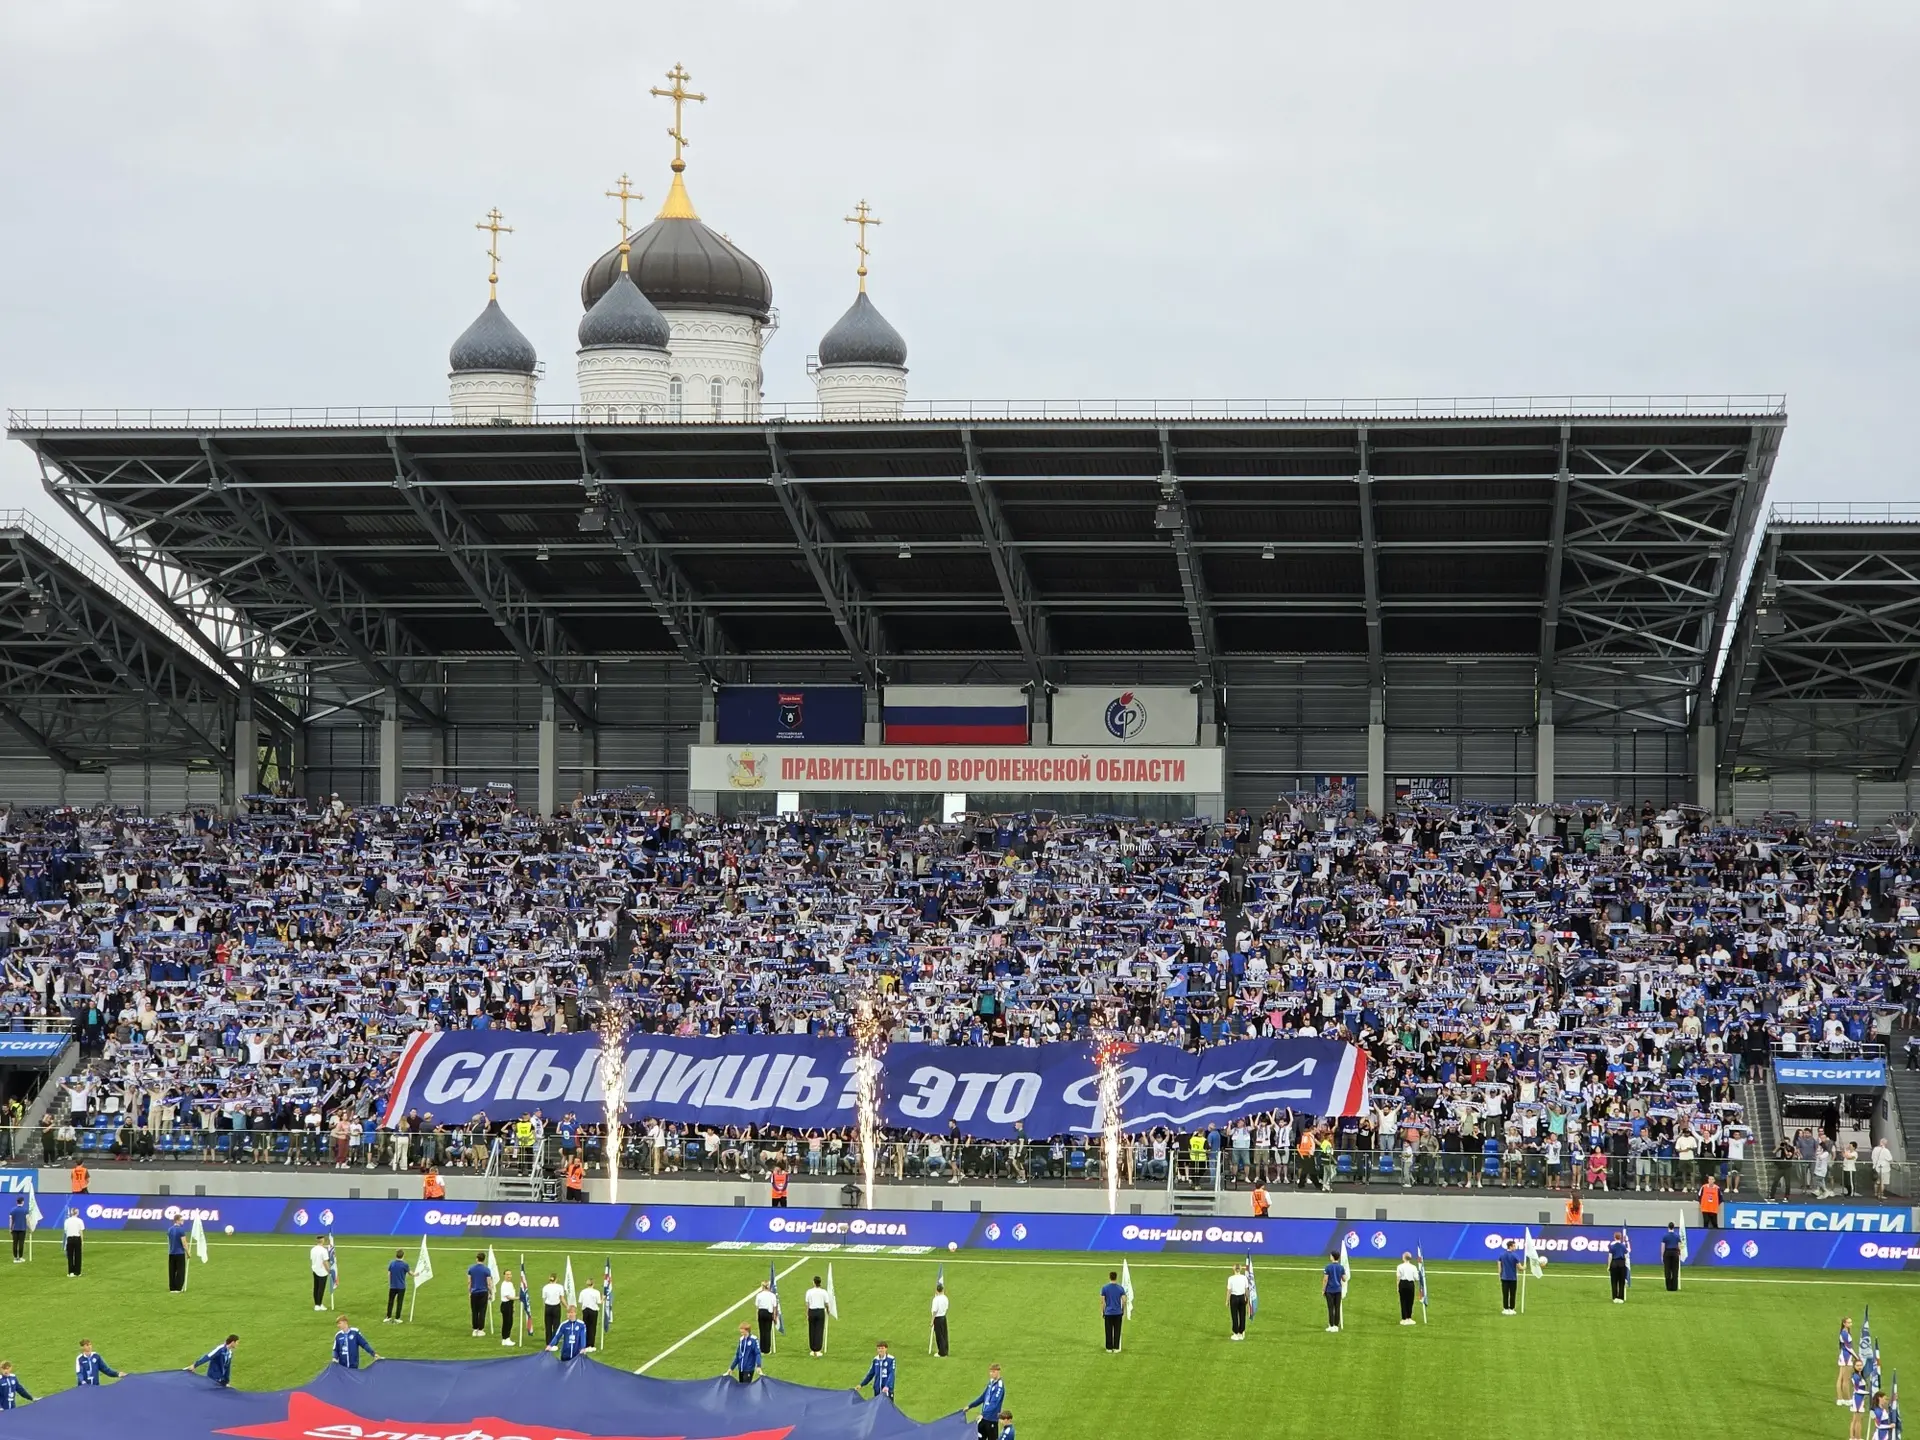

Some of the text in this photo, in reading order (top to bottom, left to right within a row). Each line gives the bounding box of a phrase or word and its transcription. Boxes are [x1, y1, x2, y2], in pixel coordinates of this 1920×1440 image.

[781, 754, 1186, 782] ПРАВИТЕЛЬСТВО ВОРОНЕЖСКОЙ ОБЛАСТИ
[1780, 1068, 1881, 1079] БЕТСИТИ
[899, 1065, 1041, 1124] ЭТО
[86, 1204, 163, 1220] Фан-шоп
[424, 1209, 560, 1228] Фан-шоп Факел
[1731, 1209, 1906, 1233] БЕТСИТИ
[768, 1217, 907, 1236] Фан-шоп Факел
[1122, 1224, 1264, 1243] Фан-шоп Факел
